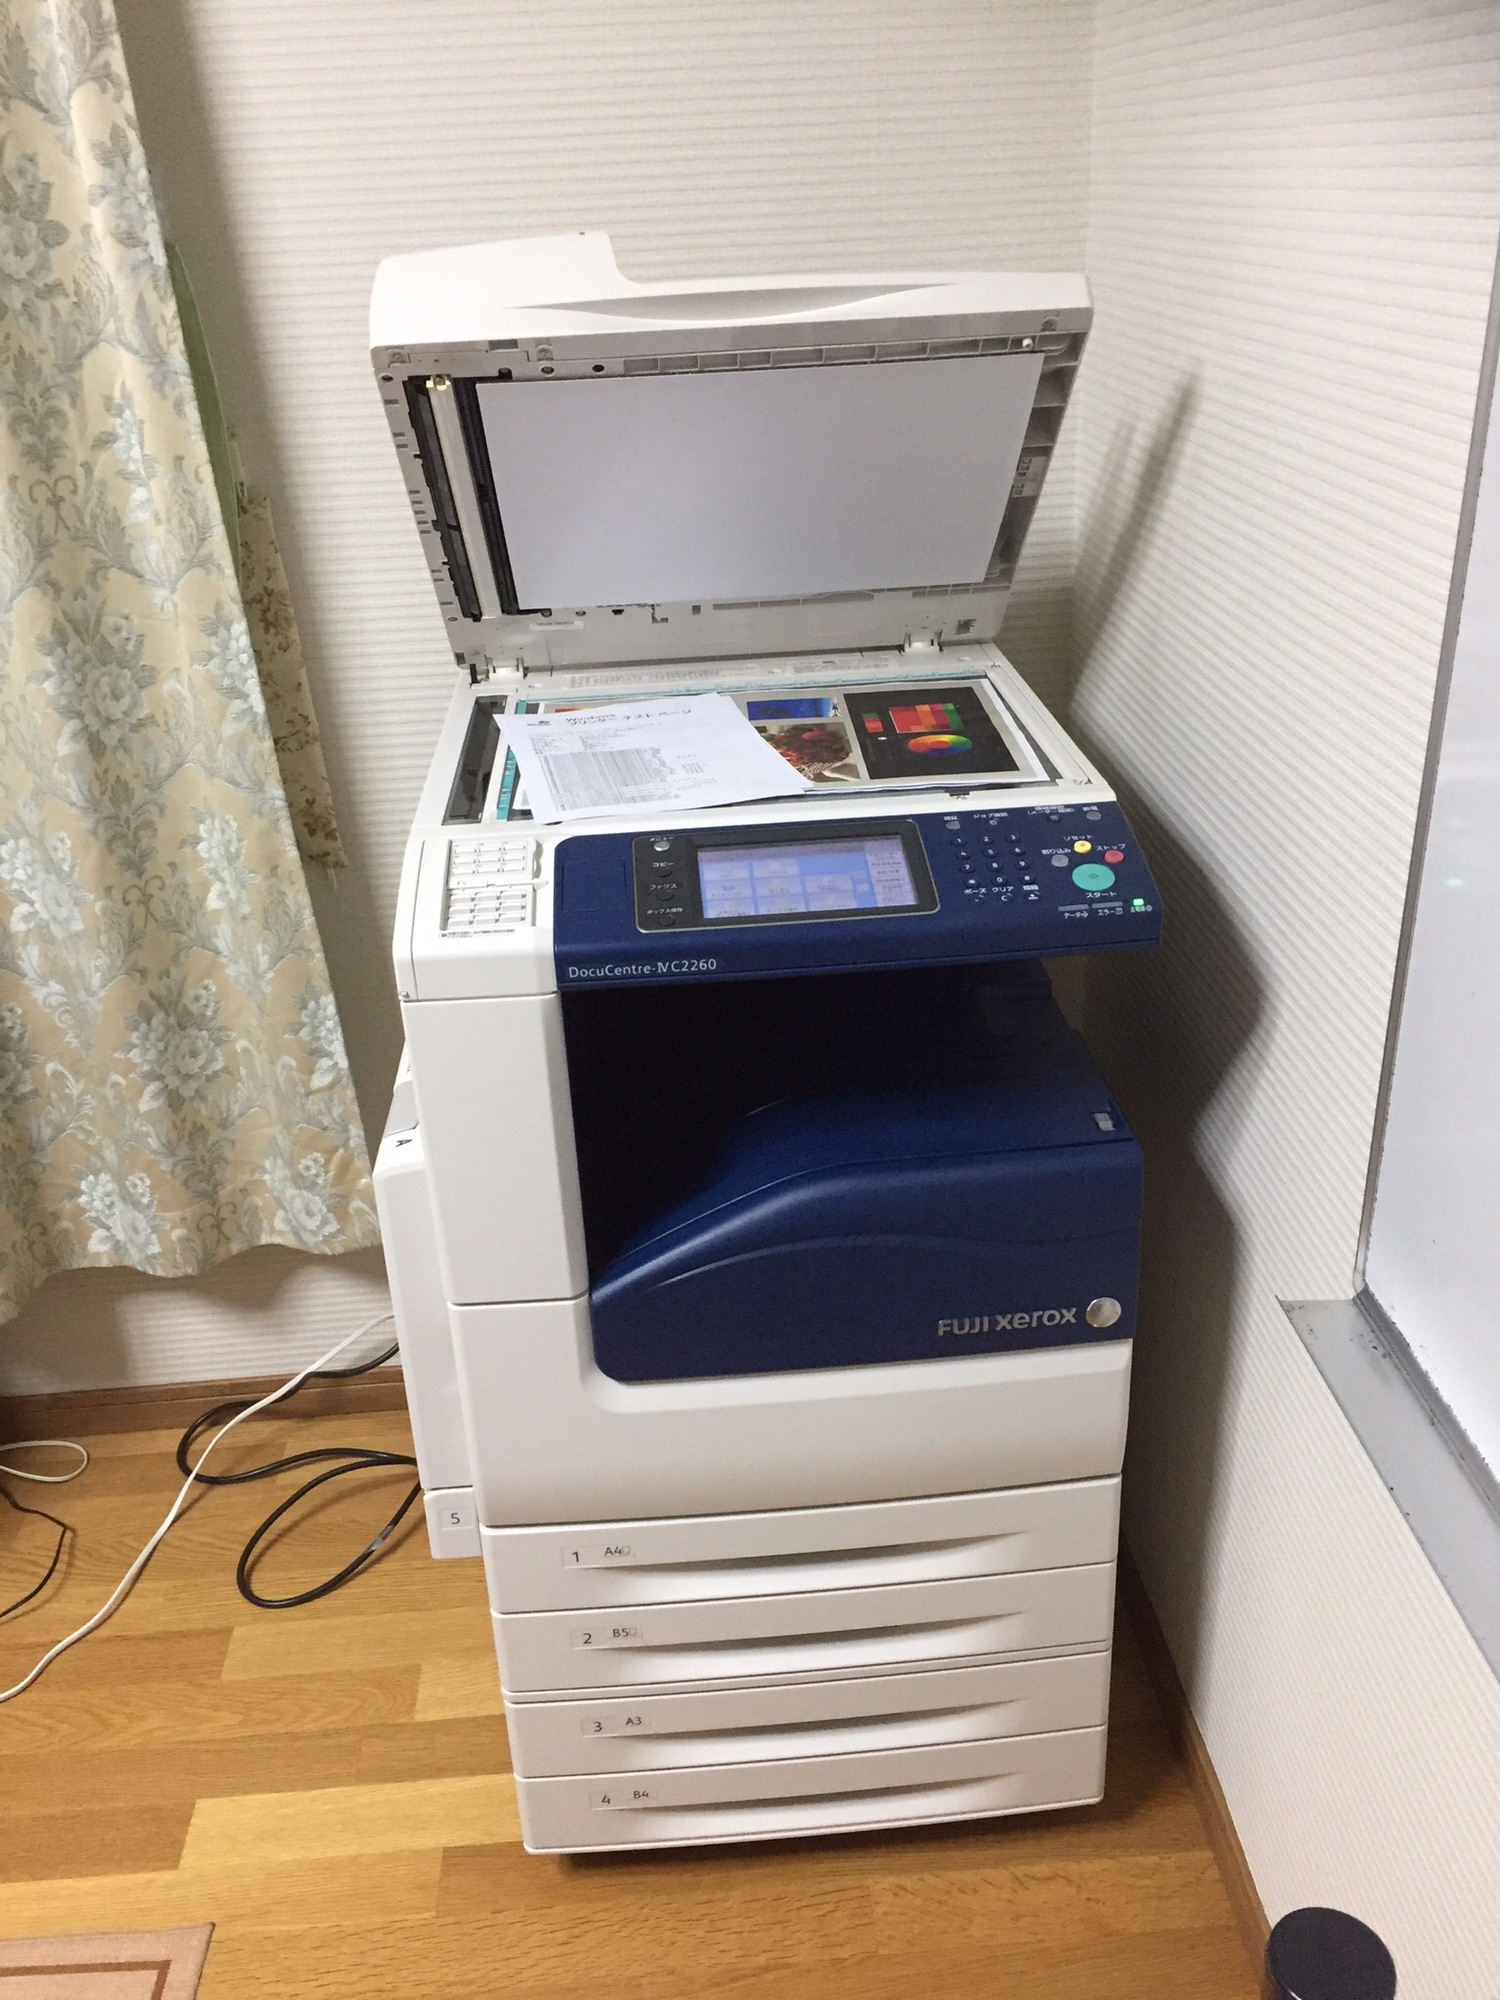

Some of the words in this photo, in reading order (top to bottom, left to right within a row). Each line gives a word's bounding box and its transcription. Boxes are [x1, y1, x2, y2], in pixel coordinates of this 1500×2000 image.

[938, 1315, 989, 1336] FUJI
[995, 1307, 1077, 1331] xerox
[451, 1512, 461, 1525] 5
[571, 1551, 580, 1563] 1
[604, 1546, 622, 1556] A4
[583, 1633, 593, 1645] 2
[612, 1628, 629, 1638] B5
[593, 1722, 603, 1732] 3
[625, 1716, 642, 1726] A3
[601, 1795, 611, 1805] 4
[633, 1790, 649, 1799] B4
